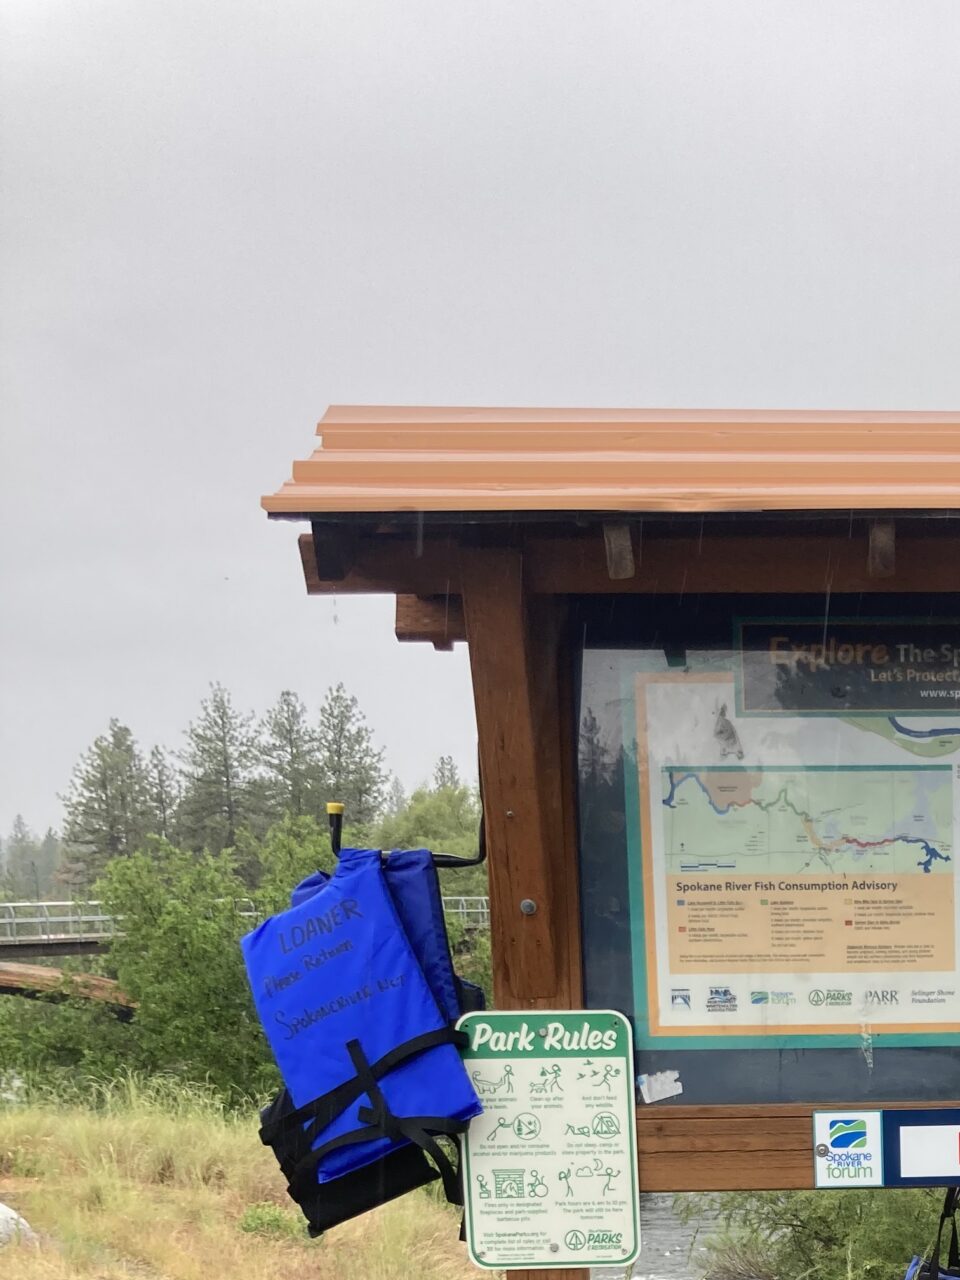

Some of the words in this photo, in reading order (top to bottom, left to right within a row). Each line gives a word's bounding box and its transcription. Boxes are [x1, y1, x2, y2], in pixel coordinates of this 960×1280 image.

[769, 637, 890, 672] Explore
[896, 643, 935, 663] The
[871, 669, 903, 682] Let's
[676, 882, 722, 893] Spokane
[725, 882, 752, 891] River
[755, 881, 776, 891] Fish
[778, 881, 848, 892] Consumption
[852, 880, 898, 892] Advisory
[279, 898, 363, 954] LOANER
[264, 970, 304, 998] Please
[826, 992, 852, 1001] PARKS
[865, 990, 899, 1002] PARR
[472, 1023, 535, 1051] Park
[544, 1022, 618, 1050] Rules
[826, 1151, 872, 1164] Spokane
[826, 1166, 873, 1180] forum
[587, 1233, 623, 1245] PARKS
